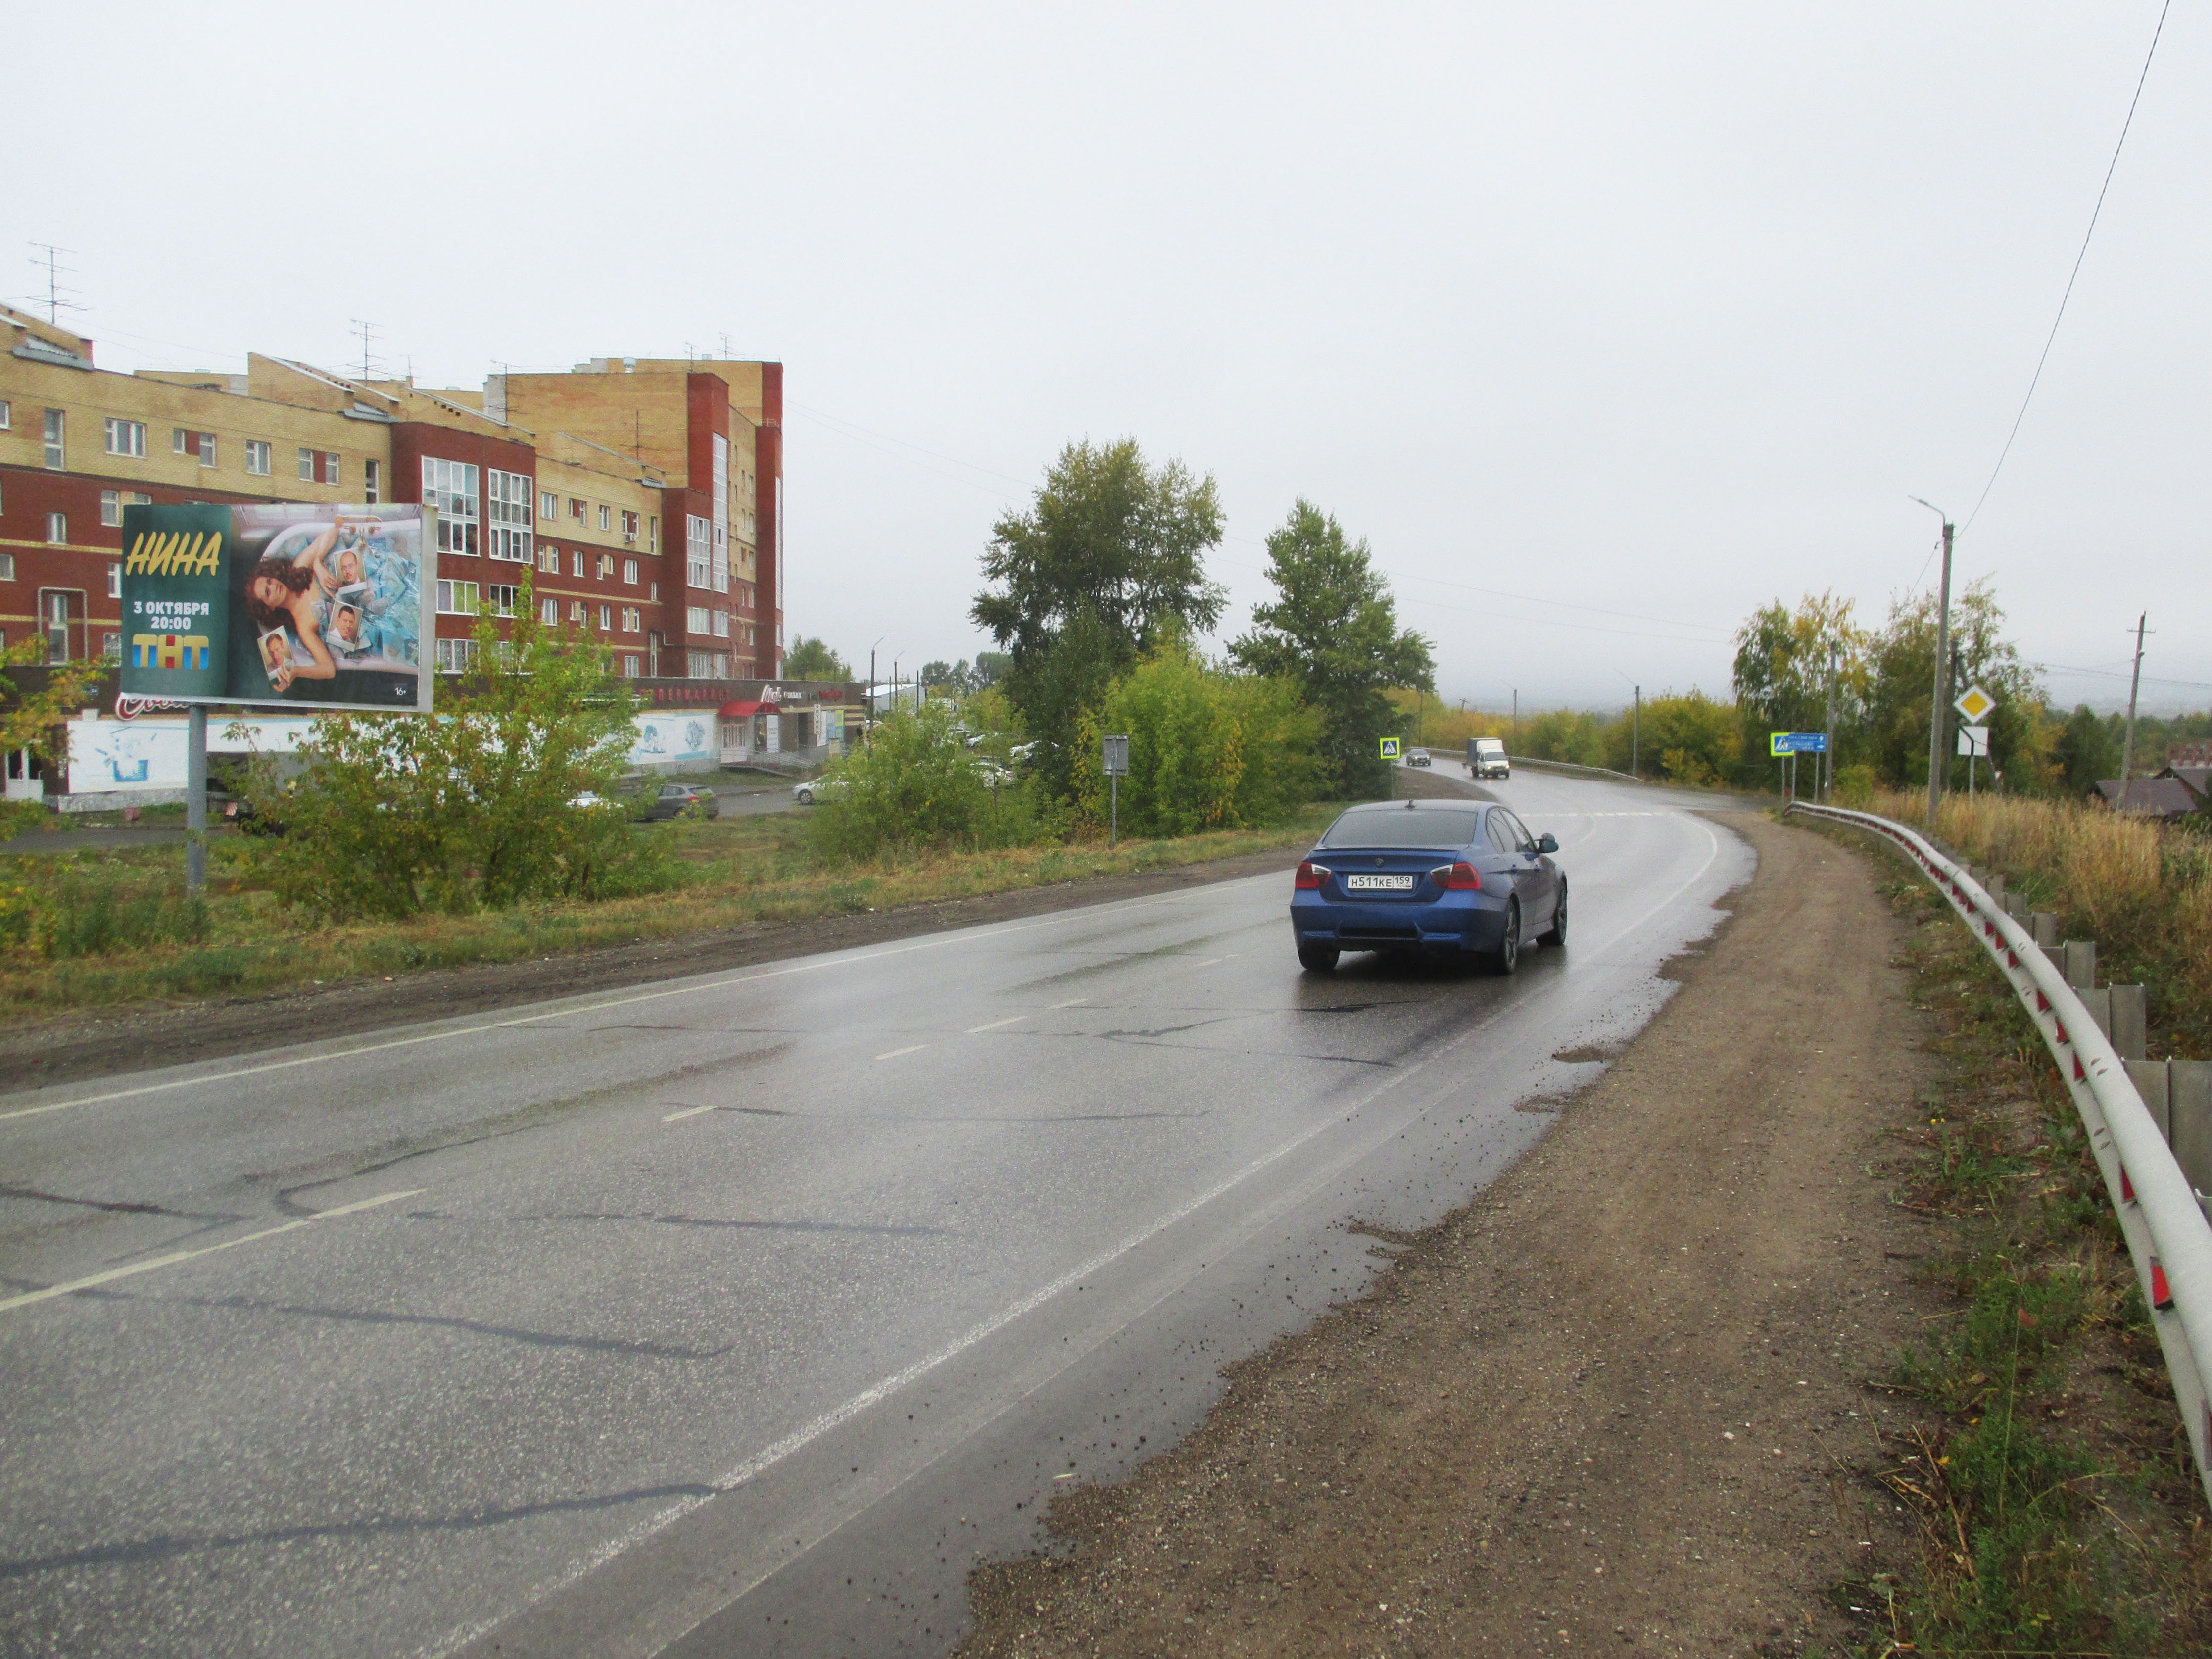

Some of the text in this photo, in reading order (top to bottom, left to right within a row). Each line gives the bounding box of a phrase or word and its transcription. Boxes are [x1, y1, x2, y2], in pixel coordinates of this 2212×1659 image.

[126, 531, 222, 576] НИНА
[134, 601, 209, 615] 3 ОКТЯБРЯ
[151, 617, 191, 630] 20:00
[133, 634, 209, 670] ТНТ
[395, 687, 406, 696] 16+
[1351, 877, 1392, 887] Н511КЕ
